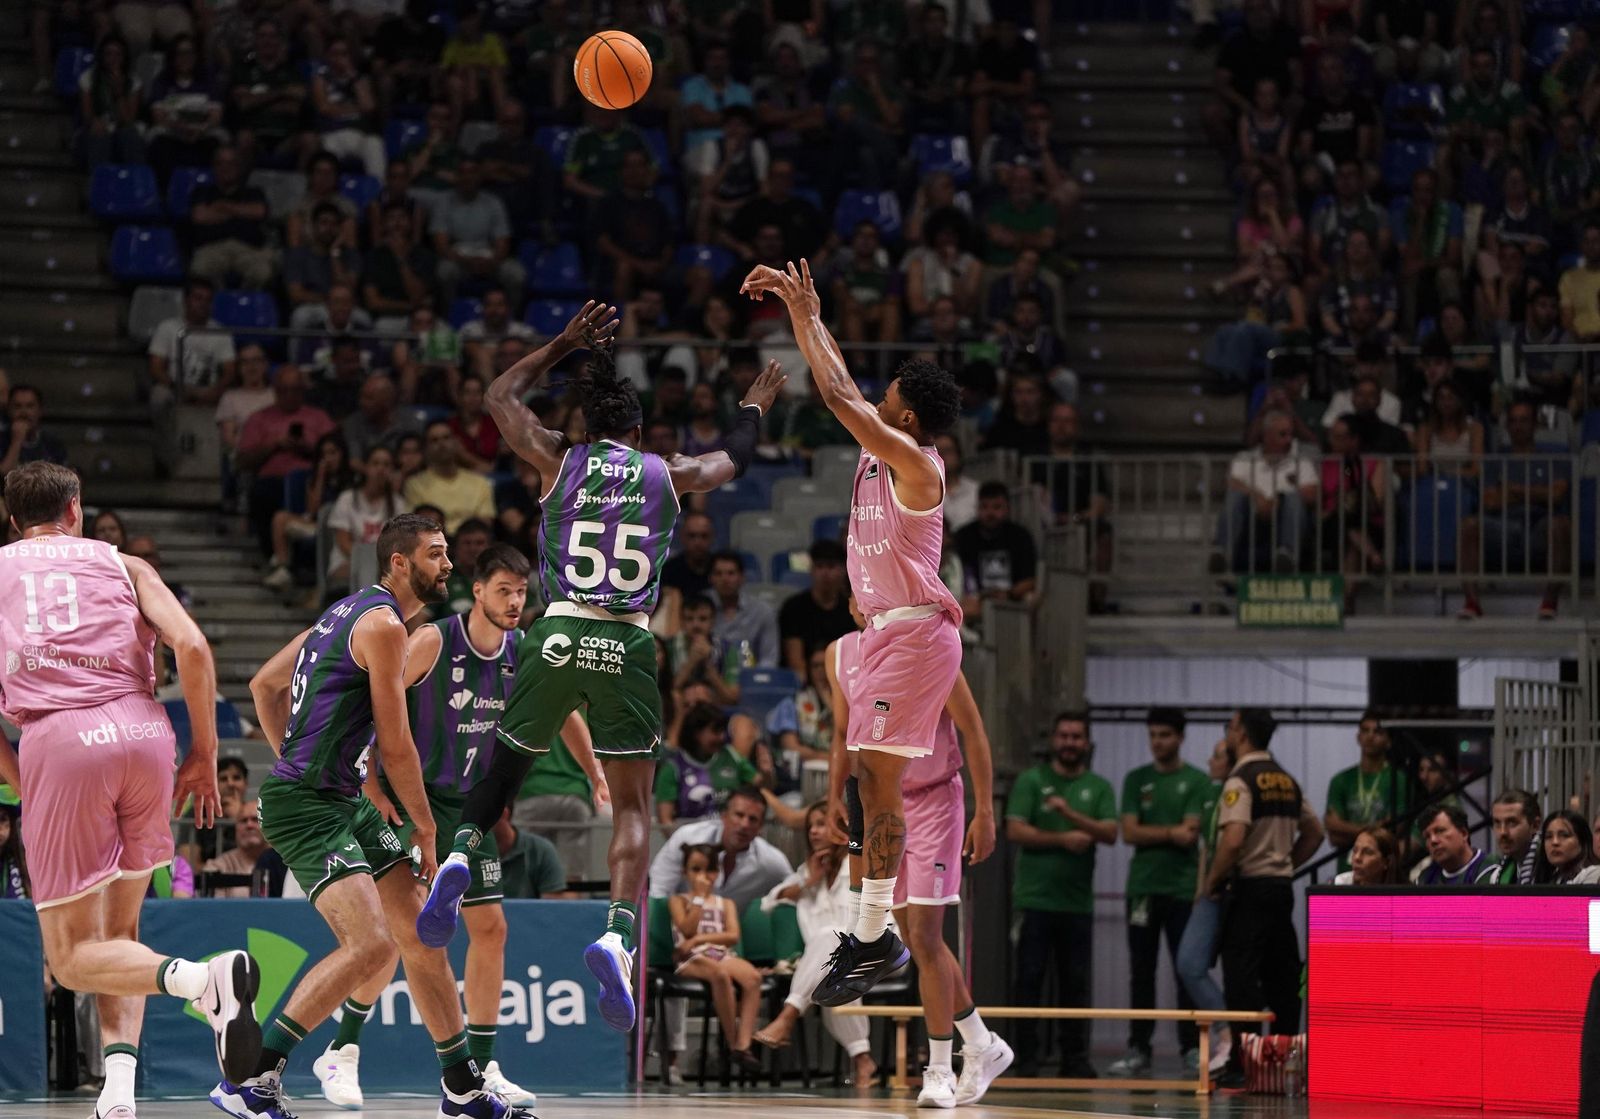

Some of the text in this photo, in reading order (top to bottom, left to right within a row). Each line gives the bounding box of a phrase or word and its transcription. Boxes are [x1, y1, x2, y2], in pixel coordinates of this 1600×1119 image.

[586, 456, 643, 483] Perry
[2, 543, 96, 559] USTOVYI
[564, 520, 651, 592] 55
[20, 570, 81, 633] 13
[23, 645, 61, 657] City of
[580, 636, 626, 655] COSTA
[577, 648, 624, 665] DEL SOL
[576, 660, 622, 675] MÁLAGA
[472, 697, 505, 711] Unica
[78, 719, 169, 747] vdf team
[463, 746, 478, 777] 7
